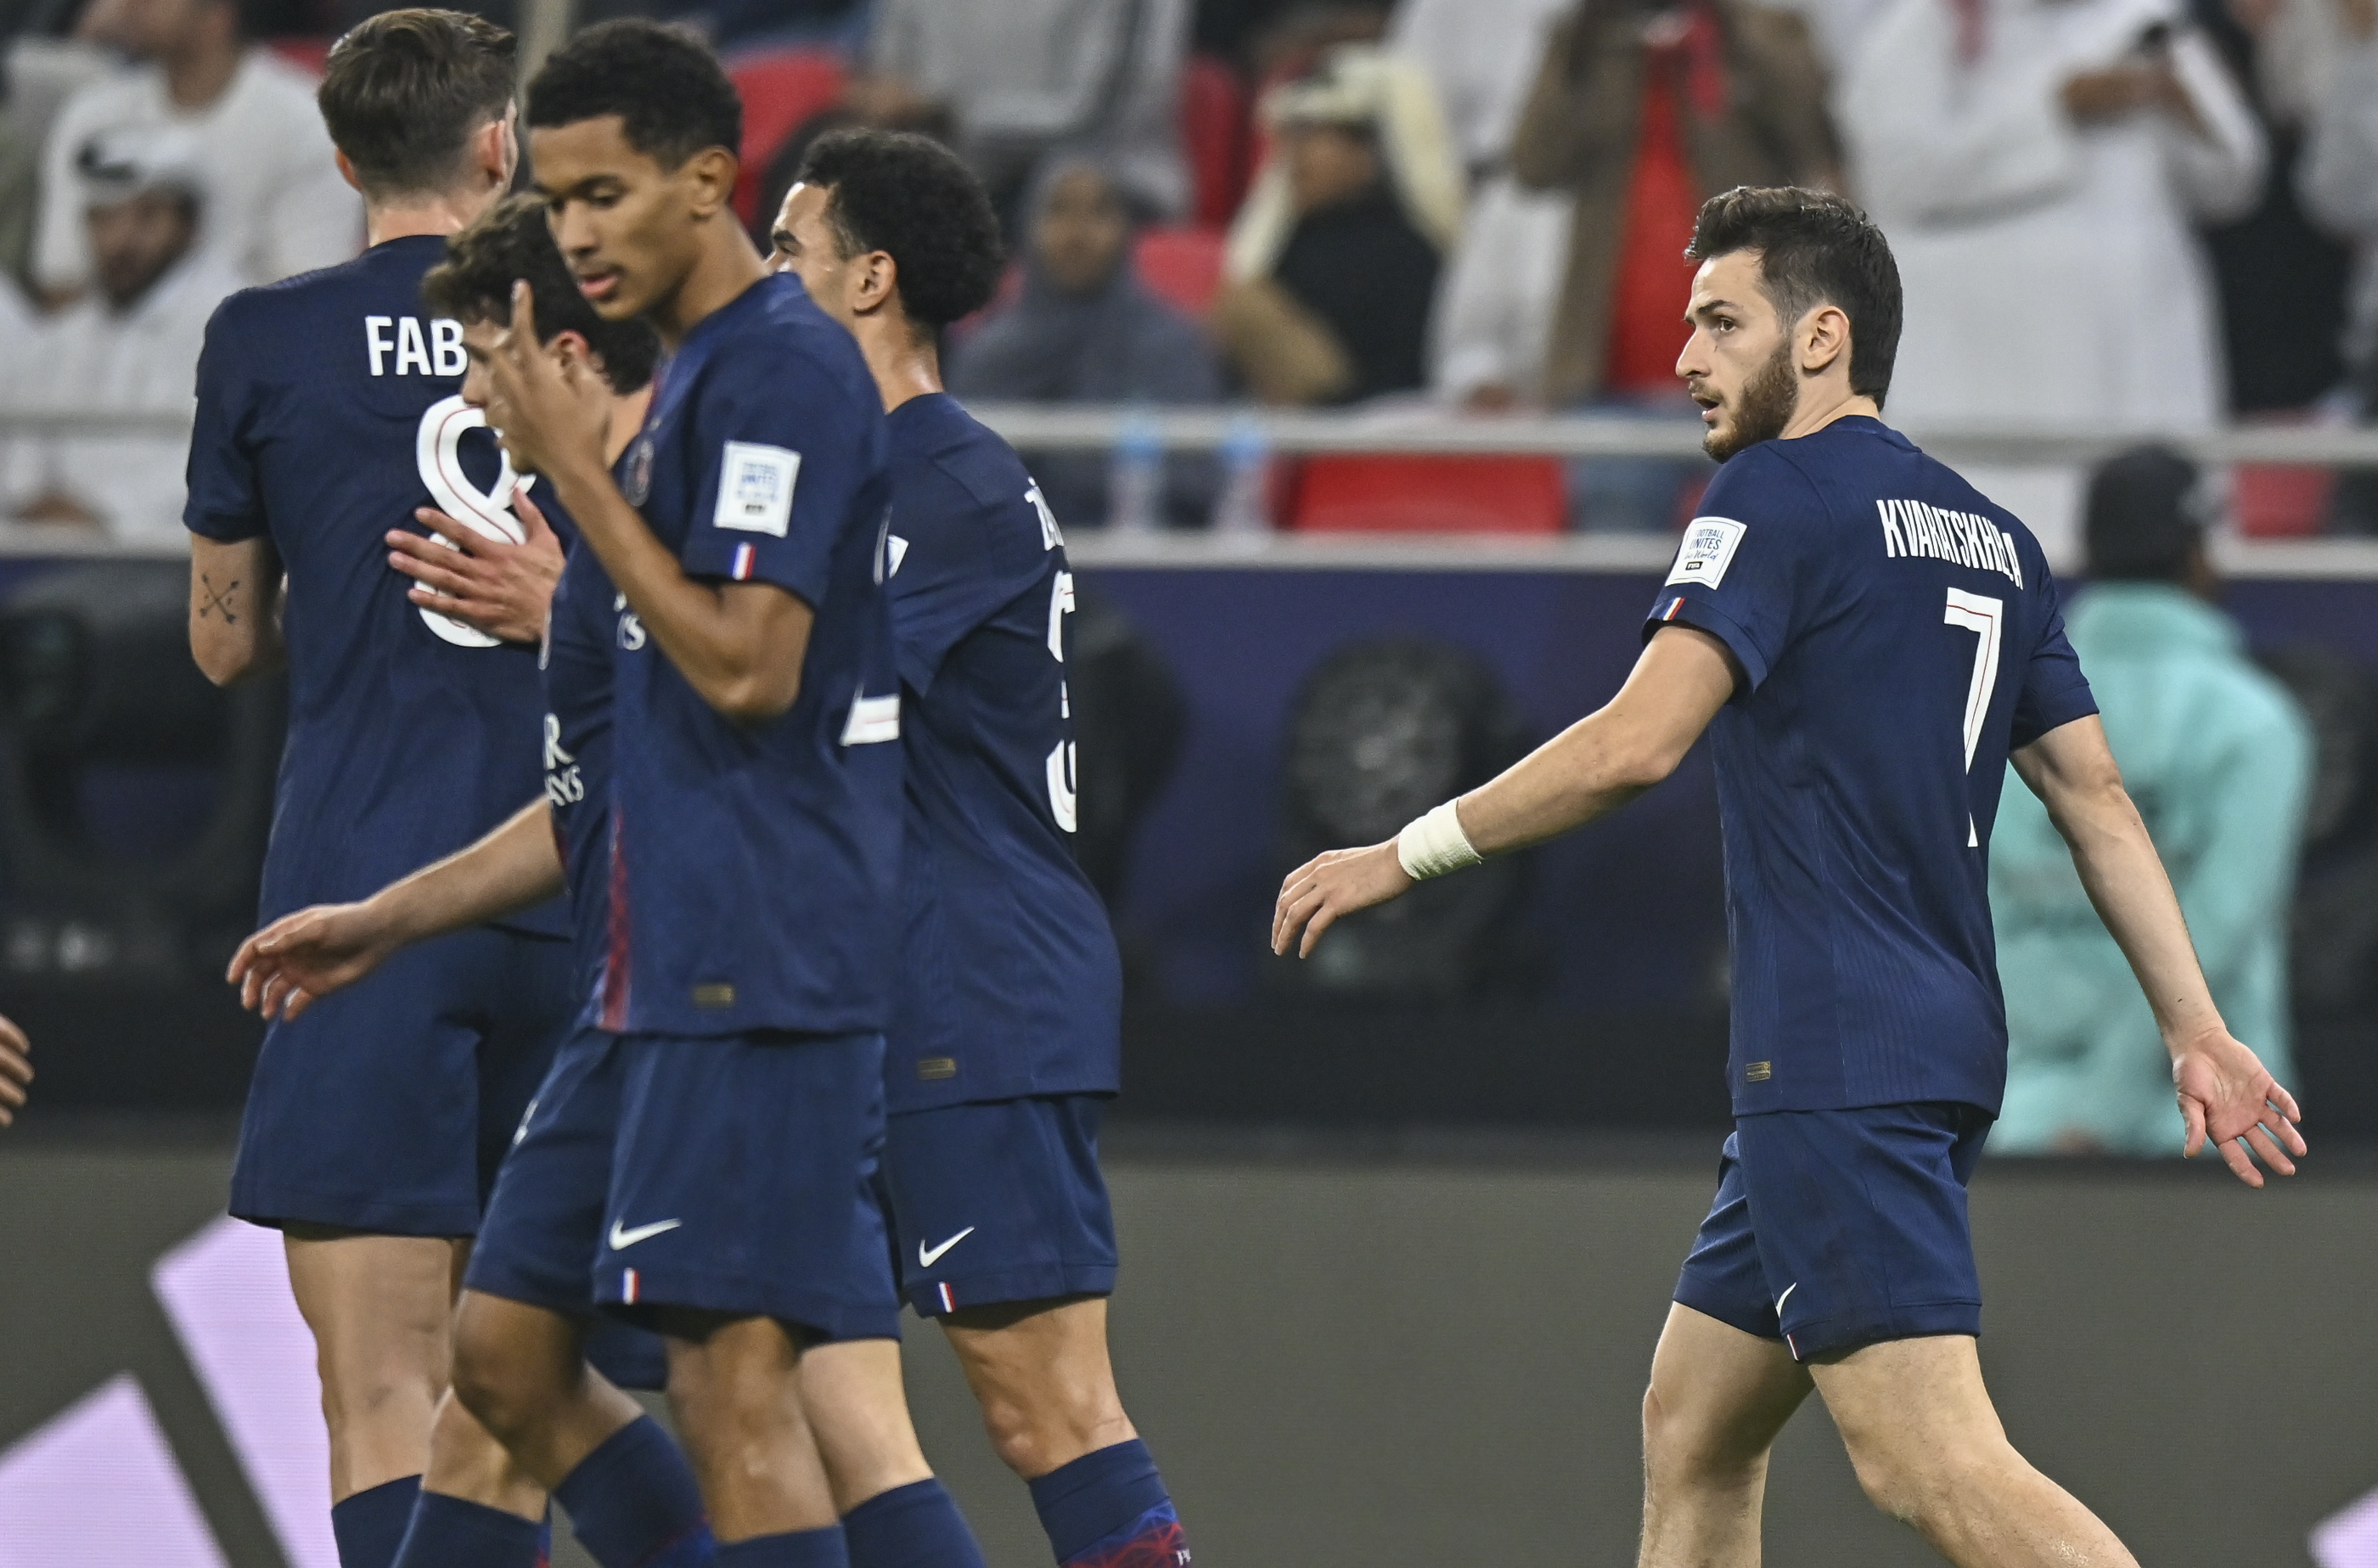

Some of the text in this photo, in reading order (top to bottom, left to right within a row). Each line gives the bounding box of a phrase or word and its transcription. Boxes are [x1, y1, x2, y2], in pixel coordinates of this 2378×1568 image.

[365, 315, 468, 376] FAB
[1689, 537, 1722, 550] UNITES
[1695, 528, 1724, 540] FOOTBALL
[1943, 587, 2003, 847] 7
